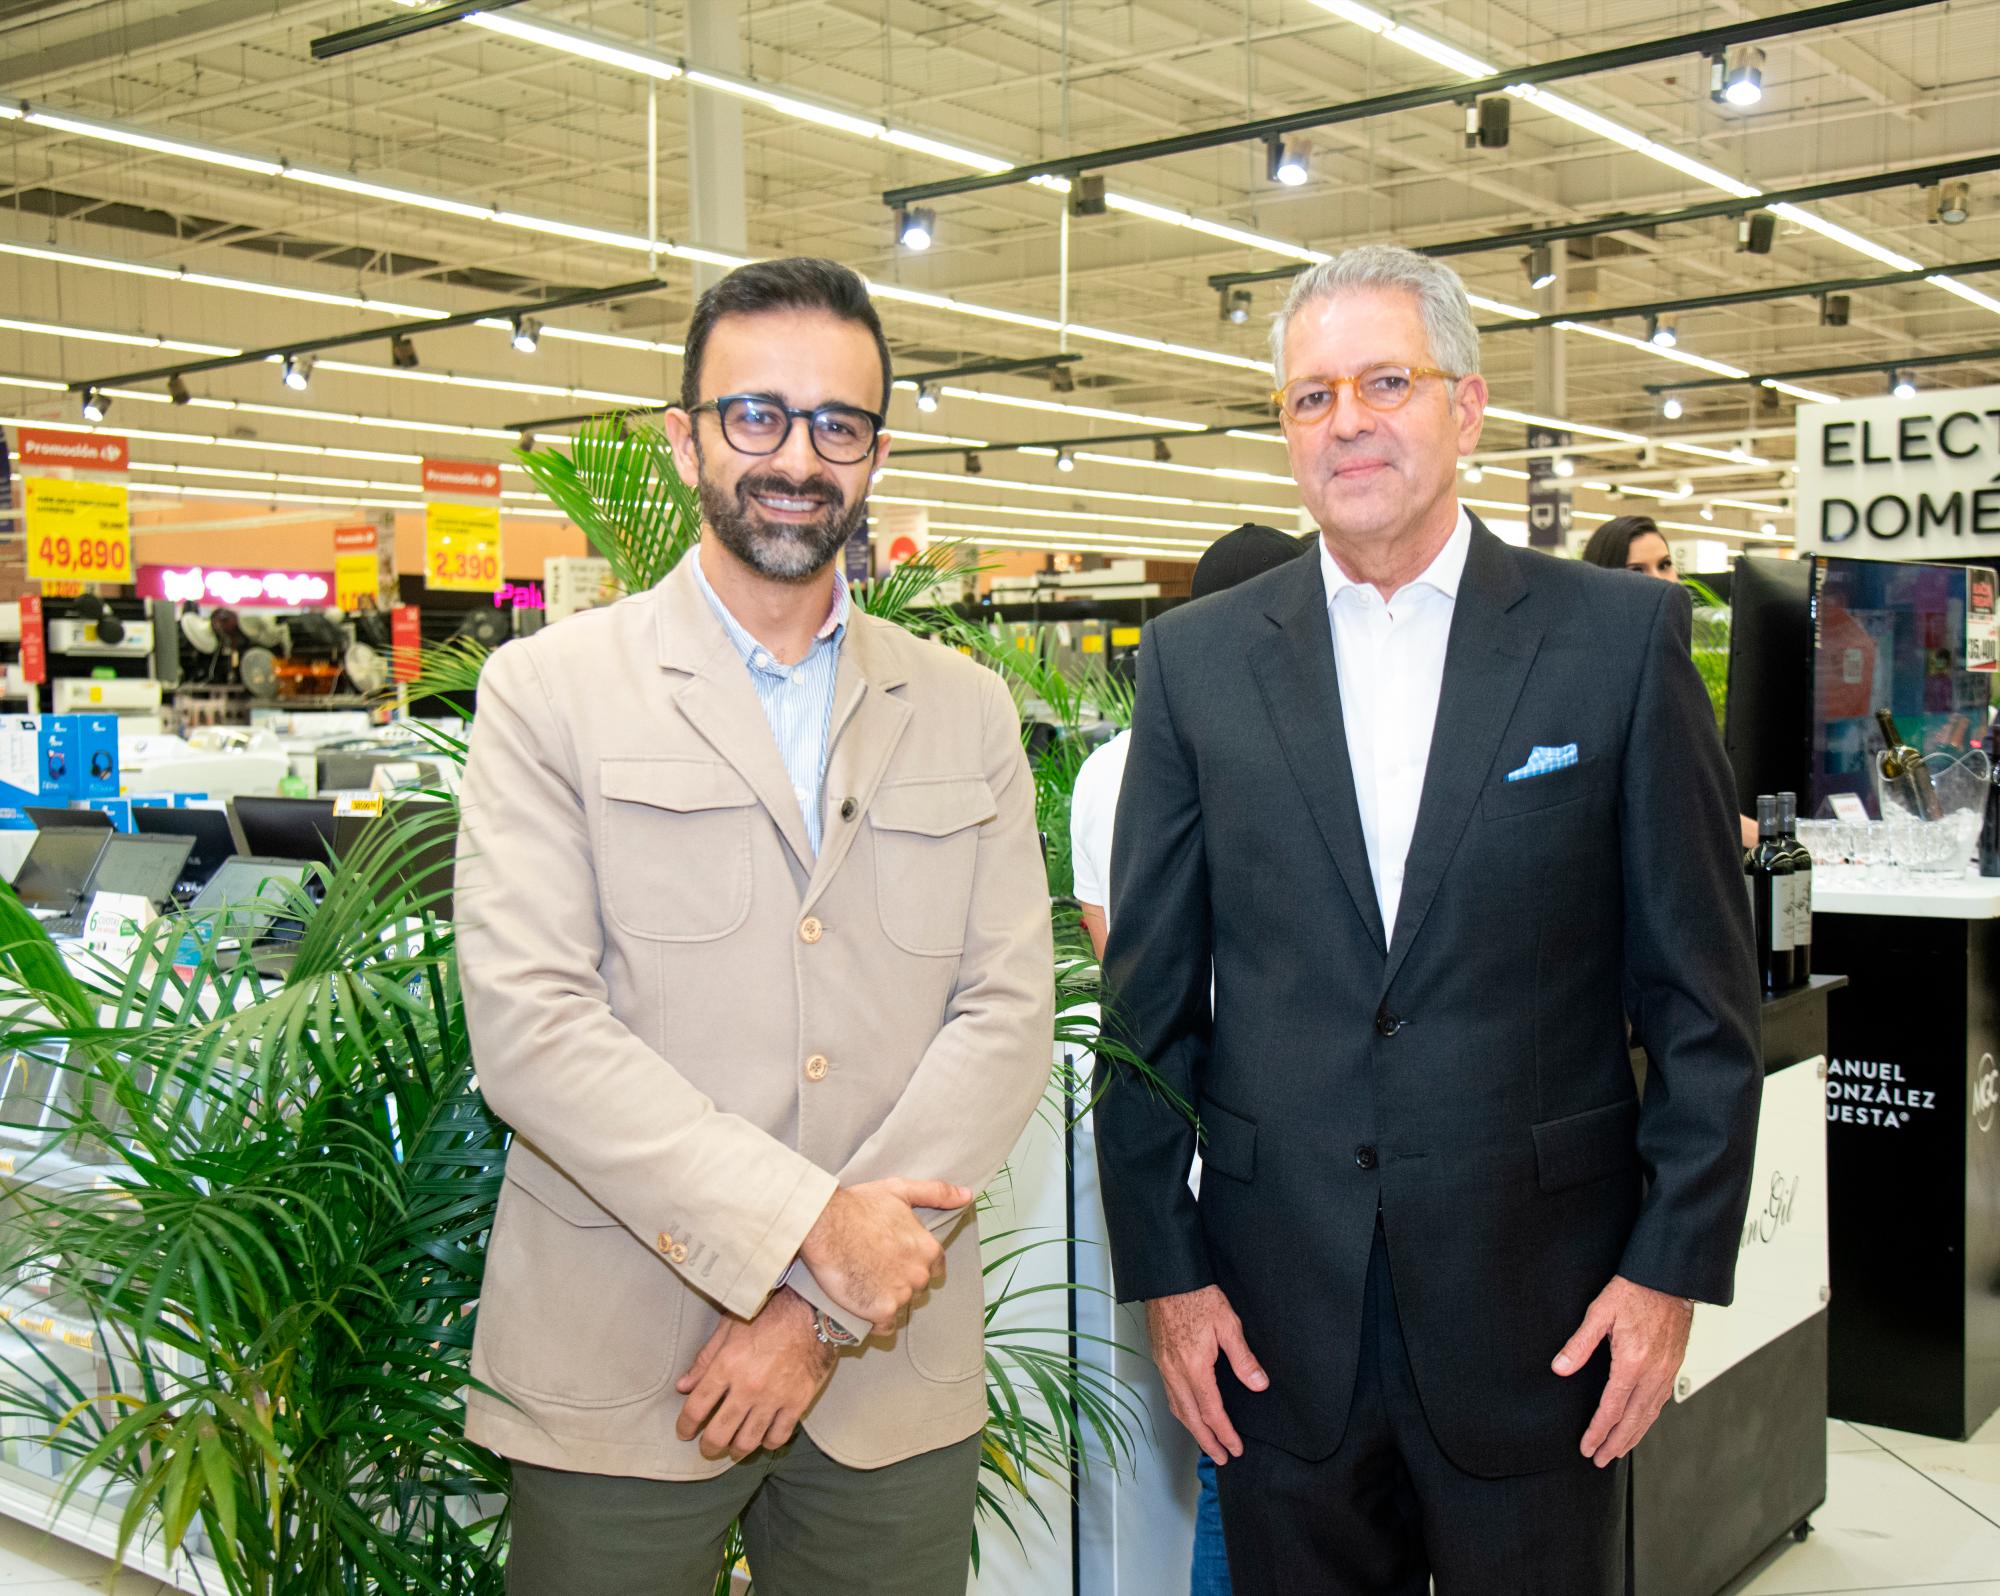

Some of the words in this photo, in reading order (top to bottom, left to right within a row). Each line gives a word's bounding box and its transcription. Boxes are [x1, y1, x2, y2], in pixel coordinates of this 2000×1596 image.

[25, 440, 99, 459] Promoción
[39, 536, 125, 572] 49,890
[435, 552, 497, 582] 2,390
